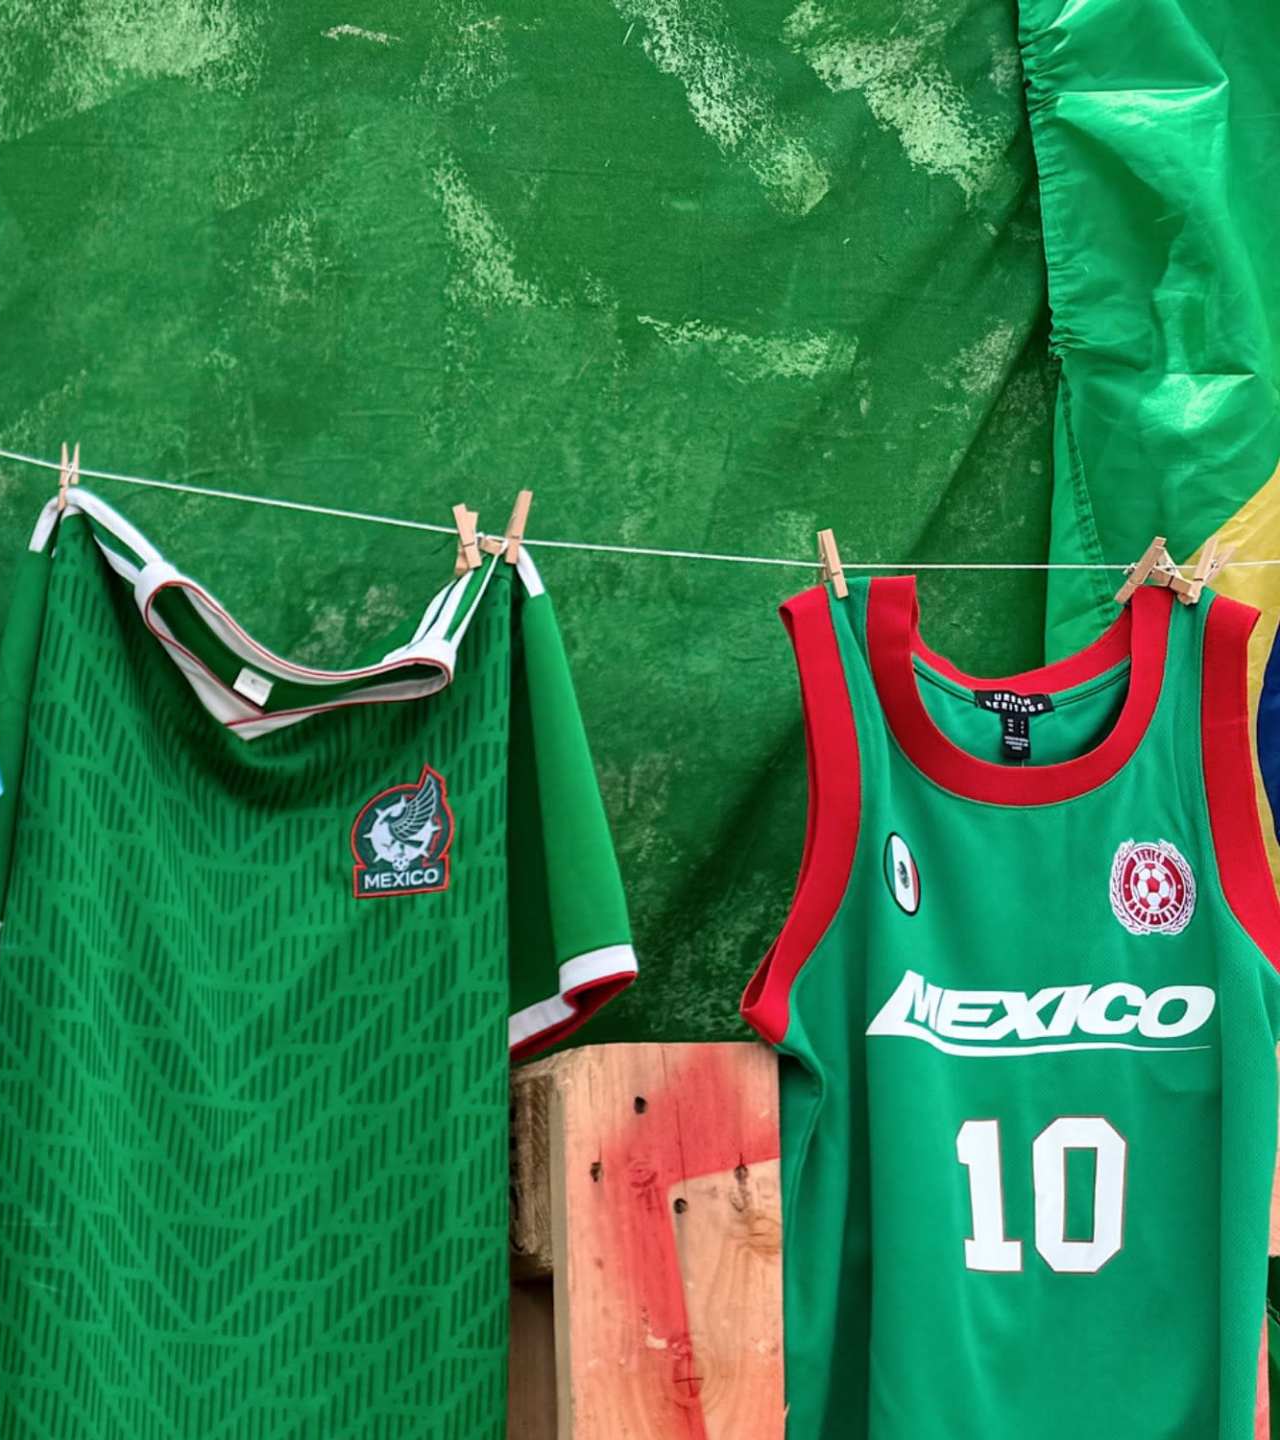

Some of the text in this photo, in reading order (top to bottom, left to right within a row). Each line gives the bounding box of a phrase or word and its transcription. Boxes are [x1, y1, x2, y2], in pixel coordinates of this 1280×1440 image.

[364, 868, 439, 889] MEXICO
[866, 970, 1215, 1041] MEXICO
[955, 1115, 1128, 1275] 10
